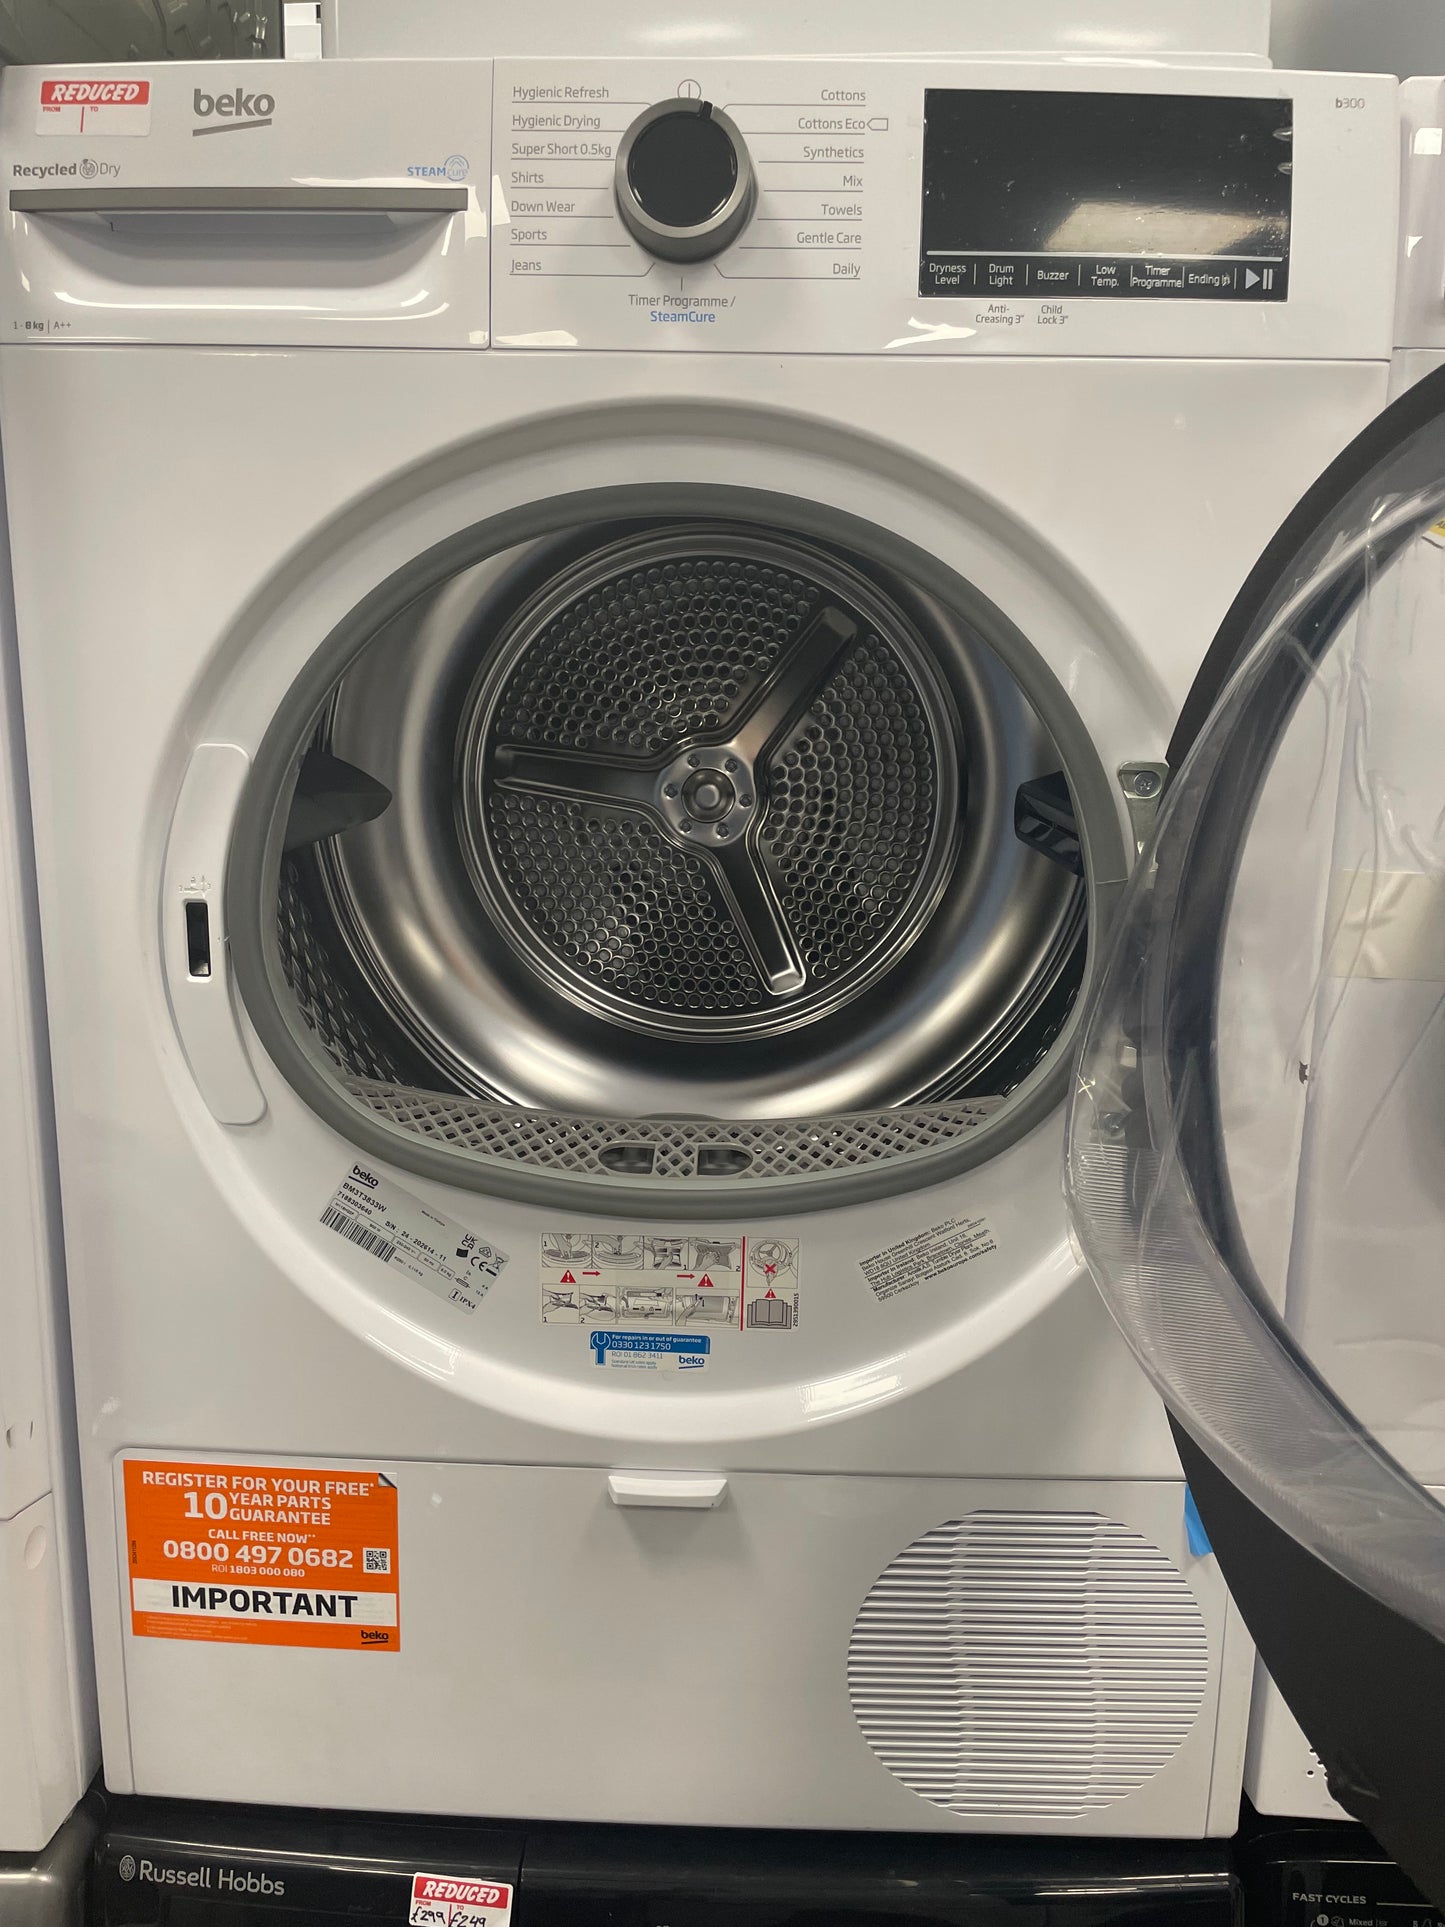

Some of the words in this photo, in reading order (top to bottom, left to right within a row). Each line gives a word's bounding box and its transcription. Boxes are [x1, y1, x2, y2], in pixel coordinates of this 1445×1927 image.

[51, 84, 139, 101] REDUCED
[513, 86, 562, 100] Hygienic
[564, 86, 609, 98] Refresh
[821, 89, 866, 101] Cottons
[194, 88, 275, 116] beko
[1336, 97, 1366, 108] b300
[512, 115, 561, 128] Hygienic
[563, 115, 600, 129] Drying
[798, 118, 842, 129] Cottons
[845, 118, 865, 129] Eco
[512, 143, 545, 156] Super
[547, 143, 578, 155] Short
[580, 144, 611, 157] 0.5kg
[803, 146, 864, 160] Synthetics
[13, 164, 76, 178] Recycled
[100, 163, 120, 177] Dry
[512, 172, 544, 183] Shirts
[843, 176, 863, 186] Mix
[511, 201, 543, 212] Down
[546, 201, 575, 212] Wear
[821, 204, 862, 215] Towels
[511, 229, 547, 242] Sports
[797, 232, 834, 243] Gentle
[837, 233, 861, 243] Care
[511, 260, 541, 273] Jeans
[833, 263, 860, 277] Daily
[929, 263, 966, 273] Dryness
[989, 264, 1014, 272] Drum
[1096, 265, 1116, 274] Low
[1145, 266, 1171, 275] Timer
[935, 276, 959, 284] Level
[1038, 271, 1069, 280] Buzzer
[1188, 274, 1220, 287] Ending
[989, 276, 1013, 287] Light
[1091, 277, 1119, 288] Temp.
[1132, 277, 1181, 289] Programme
[628, 294, 660, 306] Timer
[663, 295, 728, 309] Programme
[988, 304, 1009, 313] Anti-
[1041, 305, 1062, 314] Child
[651, 311, 715, 322] SteamCure
[976, 315, 1013, 325] Creasing
[1038, 315, 1057, 324] Lock
[54, 321, 72, 330] A++
[352, 1165, 379, 1187] beko
[400, 1230, 409, 1238] 24
[858, 1253, 881, 1266] Importer
[887, 1242, 904, 1252] United
[930, 1223, 944, 1232] Beko
[943, 1217, 955, 1226] PLC
[679, 1355, 705, 1364] beko
[143, 1471, 228, 1488] REGISTER
[232, 1476, 267, 1490] FOR
[271, 1478, 320, 1493] YOUR
[184, 1492, 227, 1520] 10
[229, 1492, 273, 1507] YEAR
[277, 1495, 331, 1510] PARTS
[230, 1508, 330, 1525] GUARANTEE
[208, 1529, 240, 1540] CALL
[242, 1531, 274, 1542] FREE
[163, 1540, 229, 1561] 0800
[235, 1545, 282, 1564] 497
[288, 1547, 353, 1568] 0682
[212, 1564, 227, 1572] ROI
[230, 1565, 257, 1575] 1803
[259, 1567, 281, 1576] 000
[283, 1568, 305, 1577] 080
[172, 1585, 358, 1618] IMPORTANT
[361, 1630, 389, 1640] beko
[139, 1860, 211, 1888] Russell
[219, 1869, 285, 1895] Hobbs
[423, 1881, 500, 1903] REDUCED
[1292, 1893, 1322, 1902] FAST
[1326, 1894, 1366, 1904] CYCLES
[411, 1906, 445, 1924] £299
[1349, 1918, 1372, 1926] Mixed
